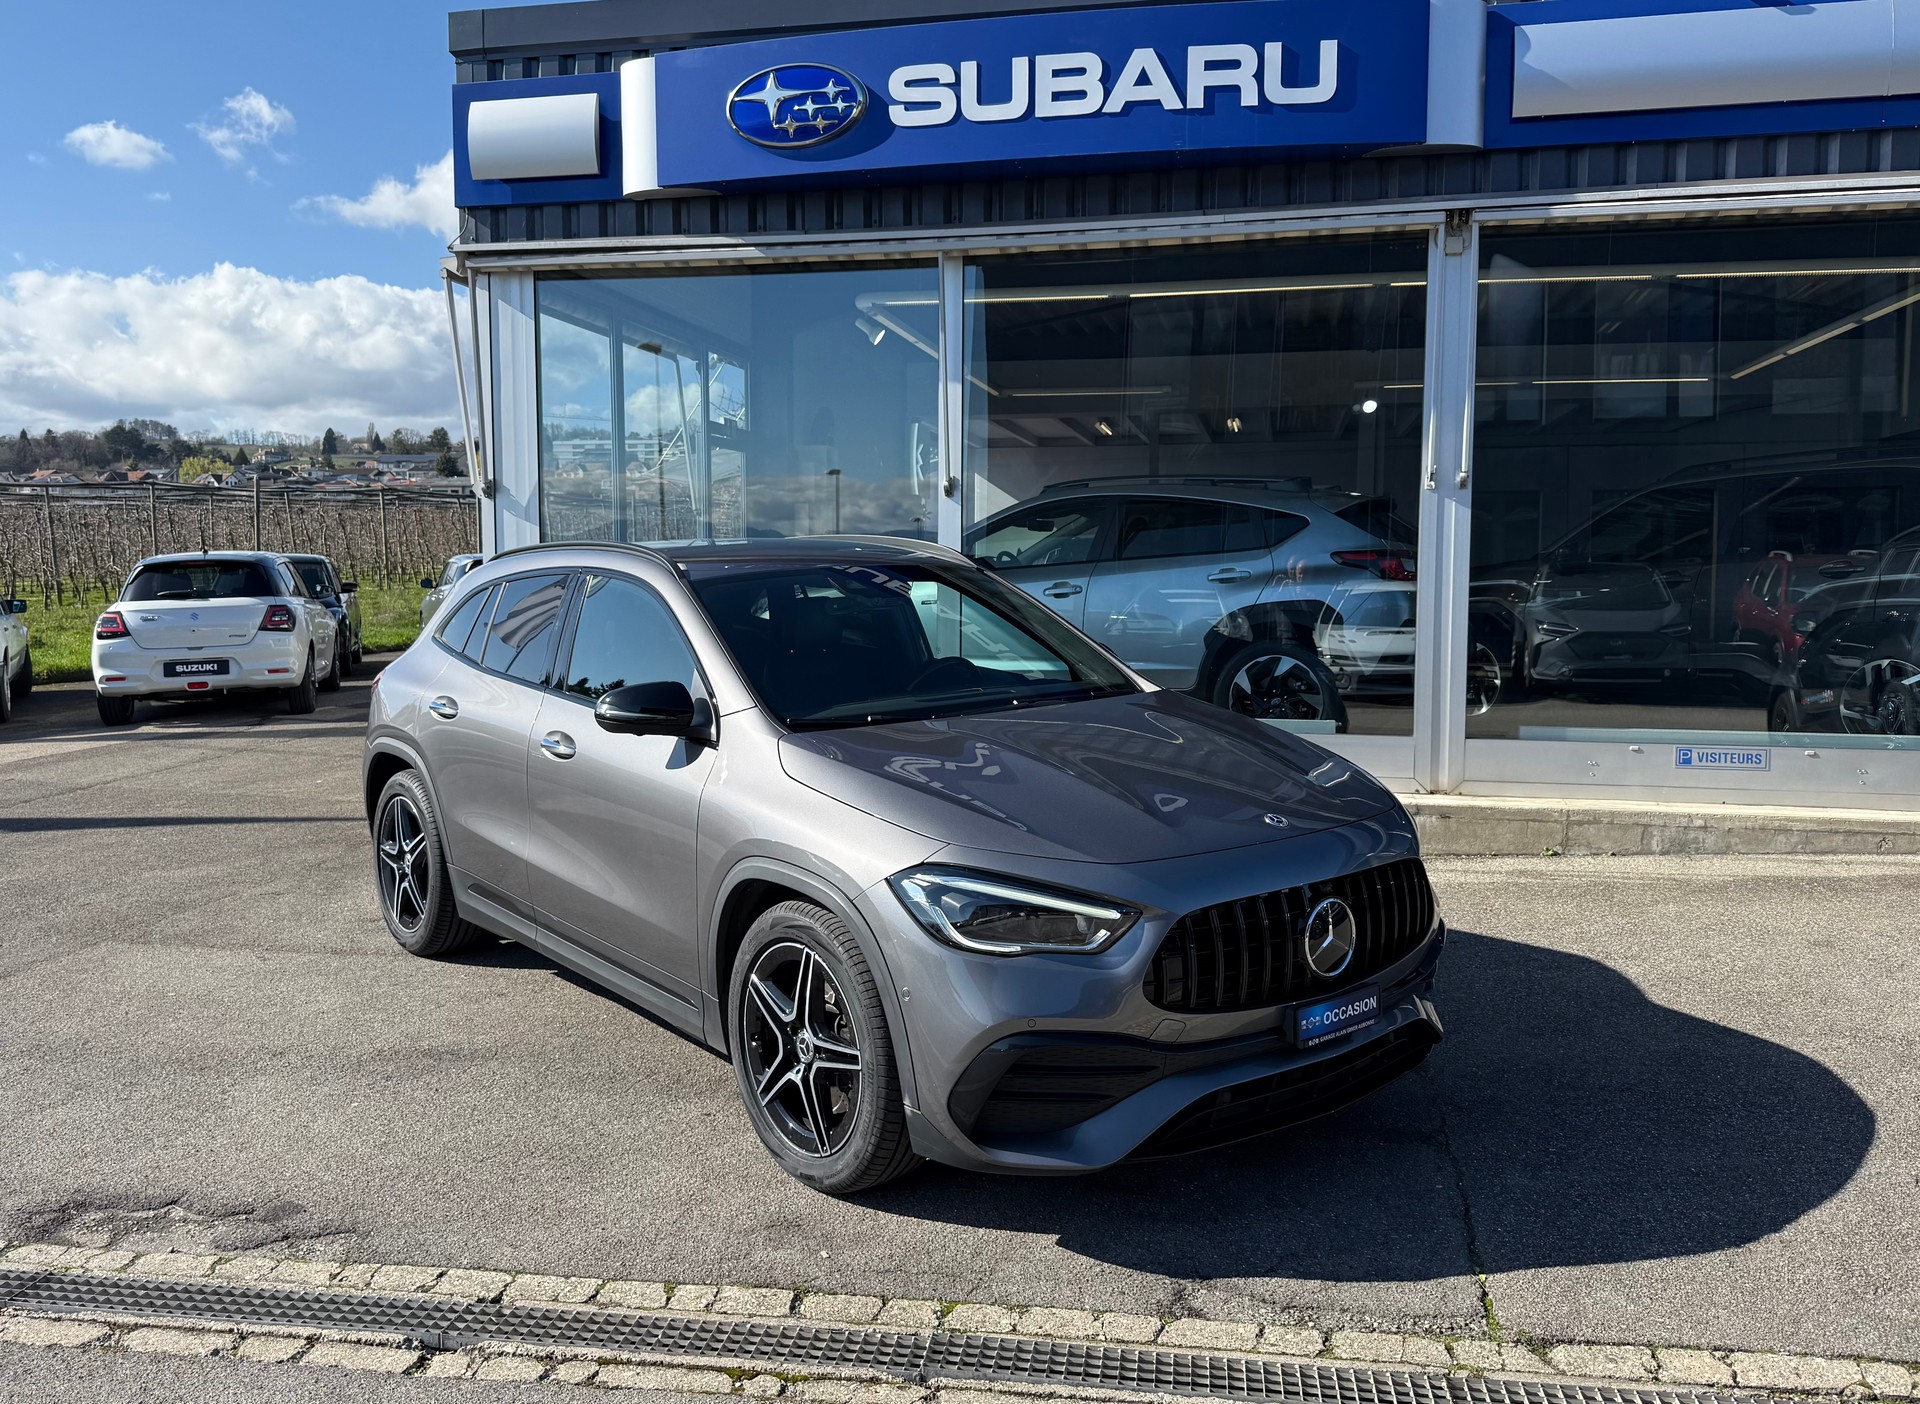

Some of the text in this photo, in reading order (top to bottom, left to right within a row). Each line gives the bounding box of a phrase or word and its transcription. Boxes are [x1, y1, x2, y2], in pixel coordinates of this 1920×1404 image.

[888, 39, 1338, 127] SUBARU
[175, 663, 218, 672] SUZUKI
[1697, 752, 1763, 764] VISITEURS
[1323, 995, 1377, 1024] OCCASION
